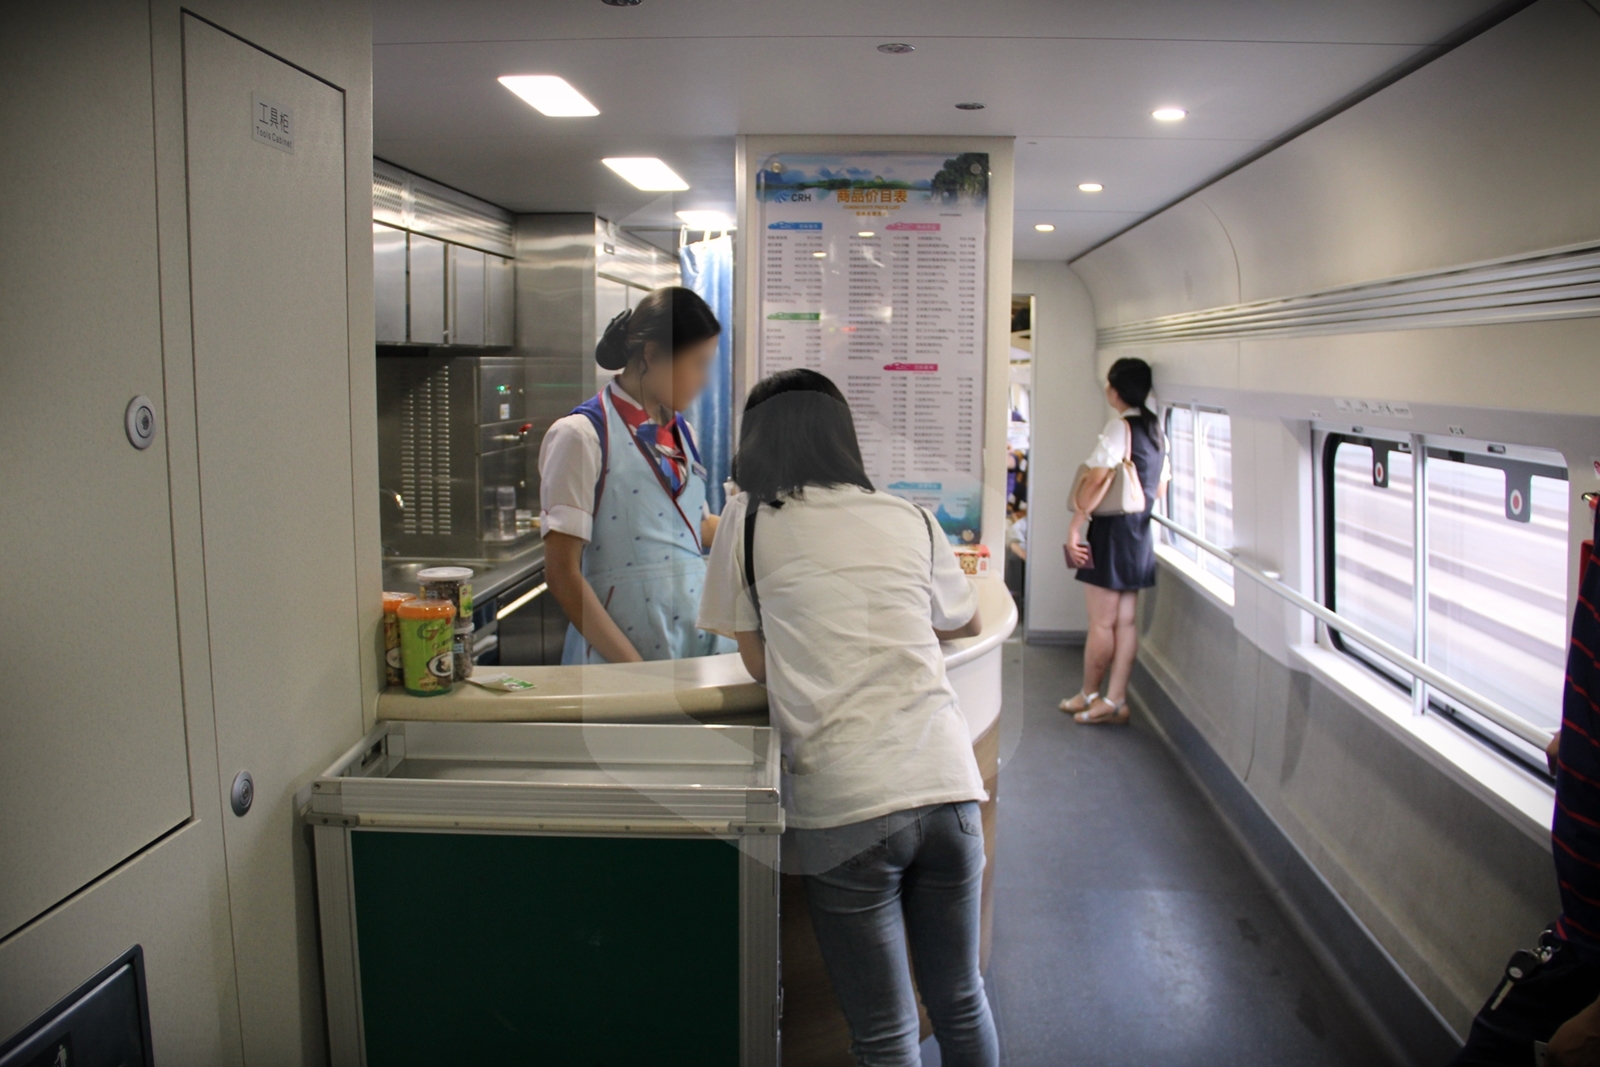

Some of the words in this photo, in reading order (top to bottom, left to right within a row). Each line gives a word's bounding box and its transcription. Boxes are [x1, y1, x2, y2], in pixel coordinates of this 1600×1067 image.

[259, 102, 289, 134] 工具柜
[256, 125, 272, 141] Tools
[272, 132, 292, 148] Cabinet
[791, 193, 812, 202] CRH
[837, 188, 907, 203] 商品价目表
